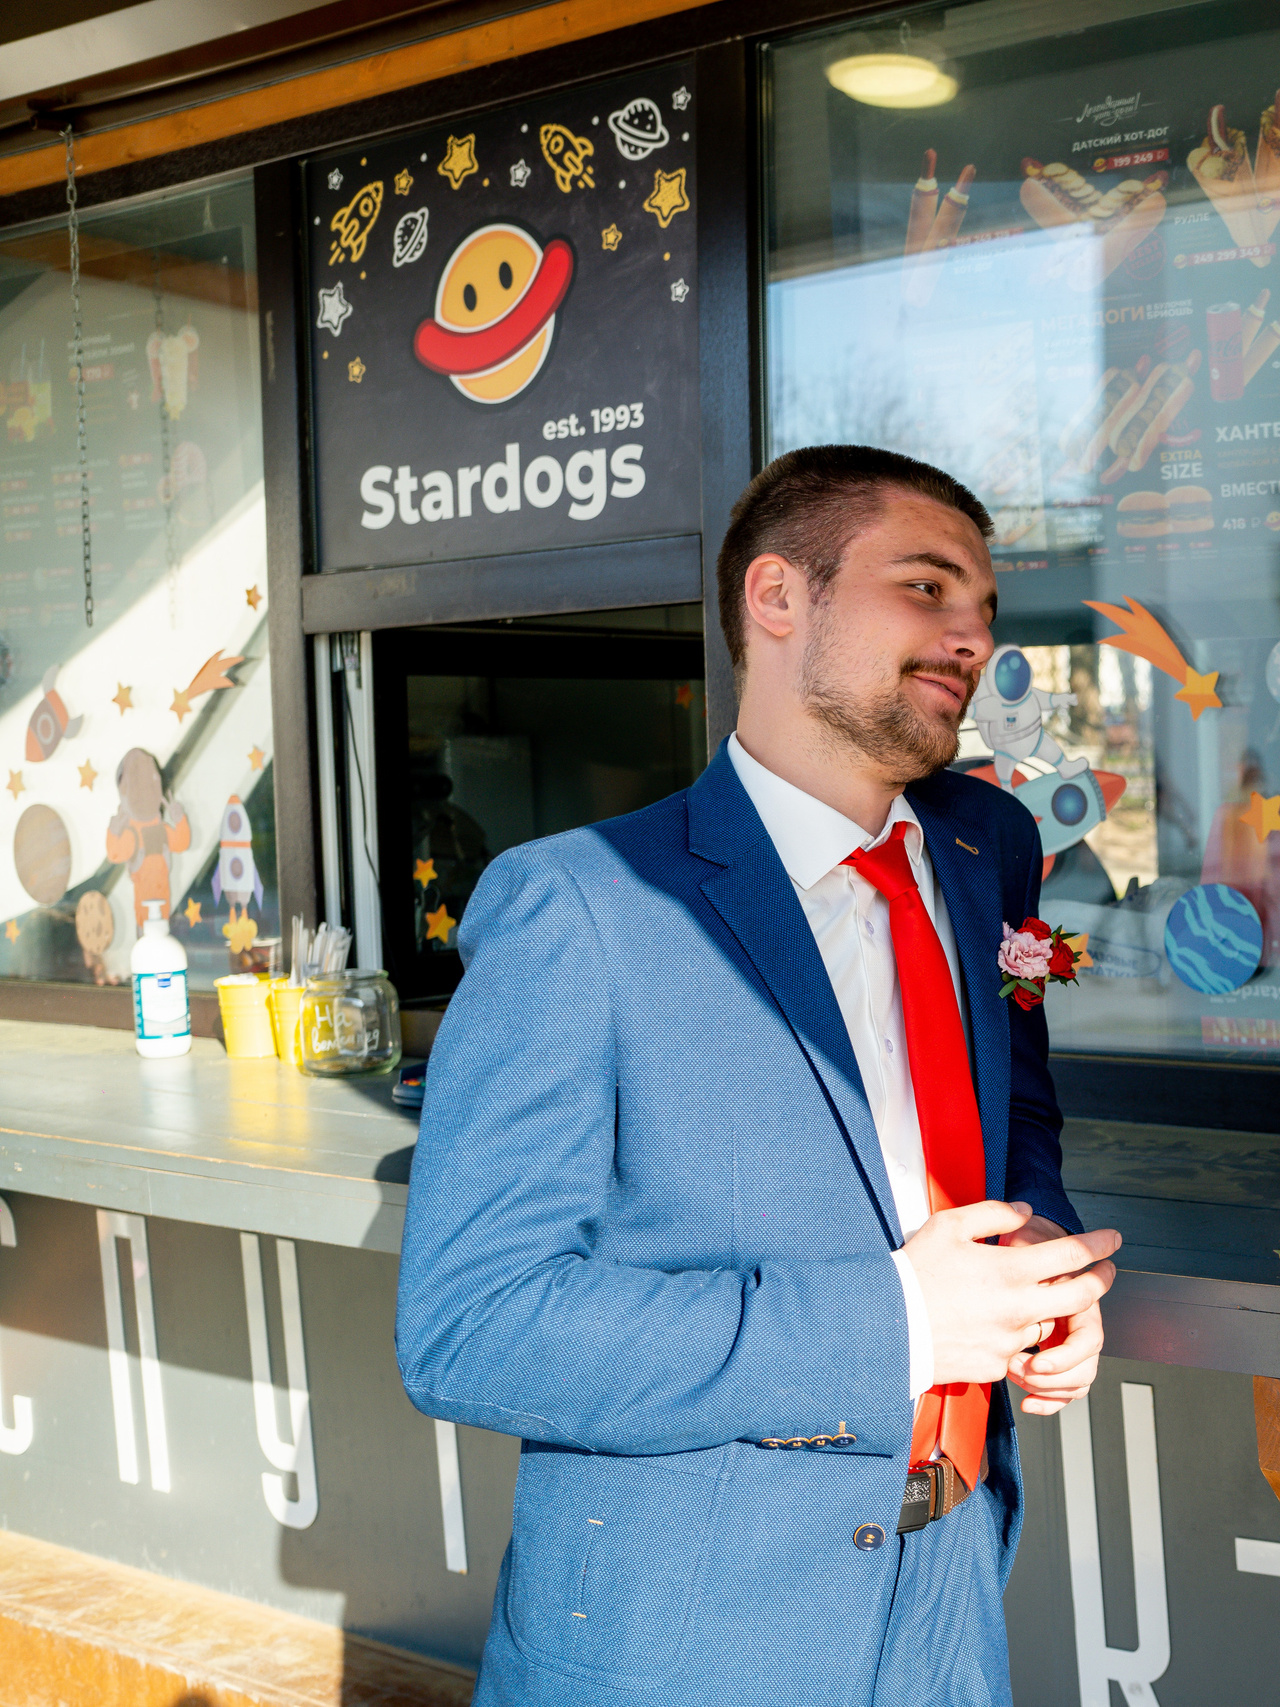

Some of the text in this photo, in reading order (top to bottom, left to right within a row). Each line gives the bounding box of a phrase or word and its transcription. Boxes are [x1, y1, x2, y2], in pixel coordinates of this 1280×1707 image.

[1072, 133, 1121, 152] ДАТСКИЙ
[1124, 126, 1169, 141] ХОТ-ДОГ
[1113, 156, 1131, 167] 199
[1134, 153, 1153, 163] 249
[1174, 212, 1210, 226] РУЛЛЕ
[1193, 253, 1214, 265] 249
[1217, 250, 1236, 261] 299
[1239, 247, 1261, 258] 349
[1146, 307, 1194, 320] БРИОШЬ
[542, 402, 645, 442] est. 1993
[1160, 449, 1202, 463] EXTRA
[1161, 462, 1203, 480] SIZE
[360, 442, 646, 530] Stardogs
[1222, 517, 1247, 530] 418
[315, 1004, 352, 1029] На
